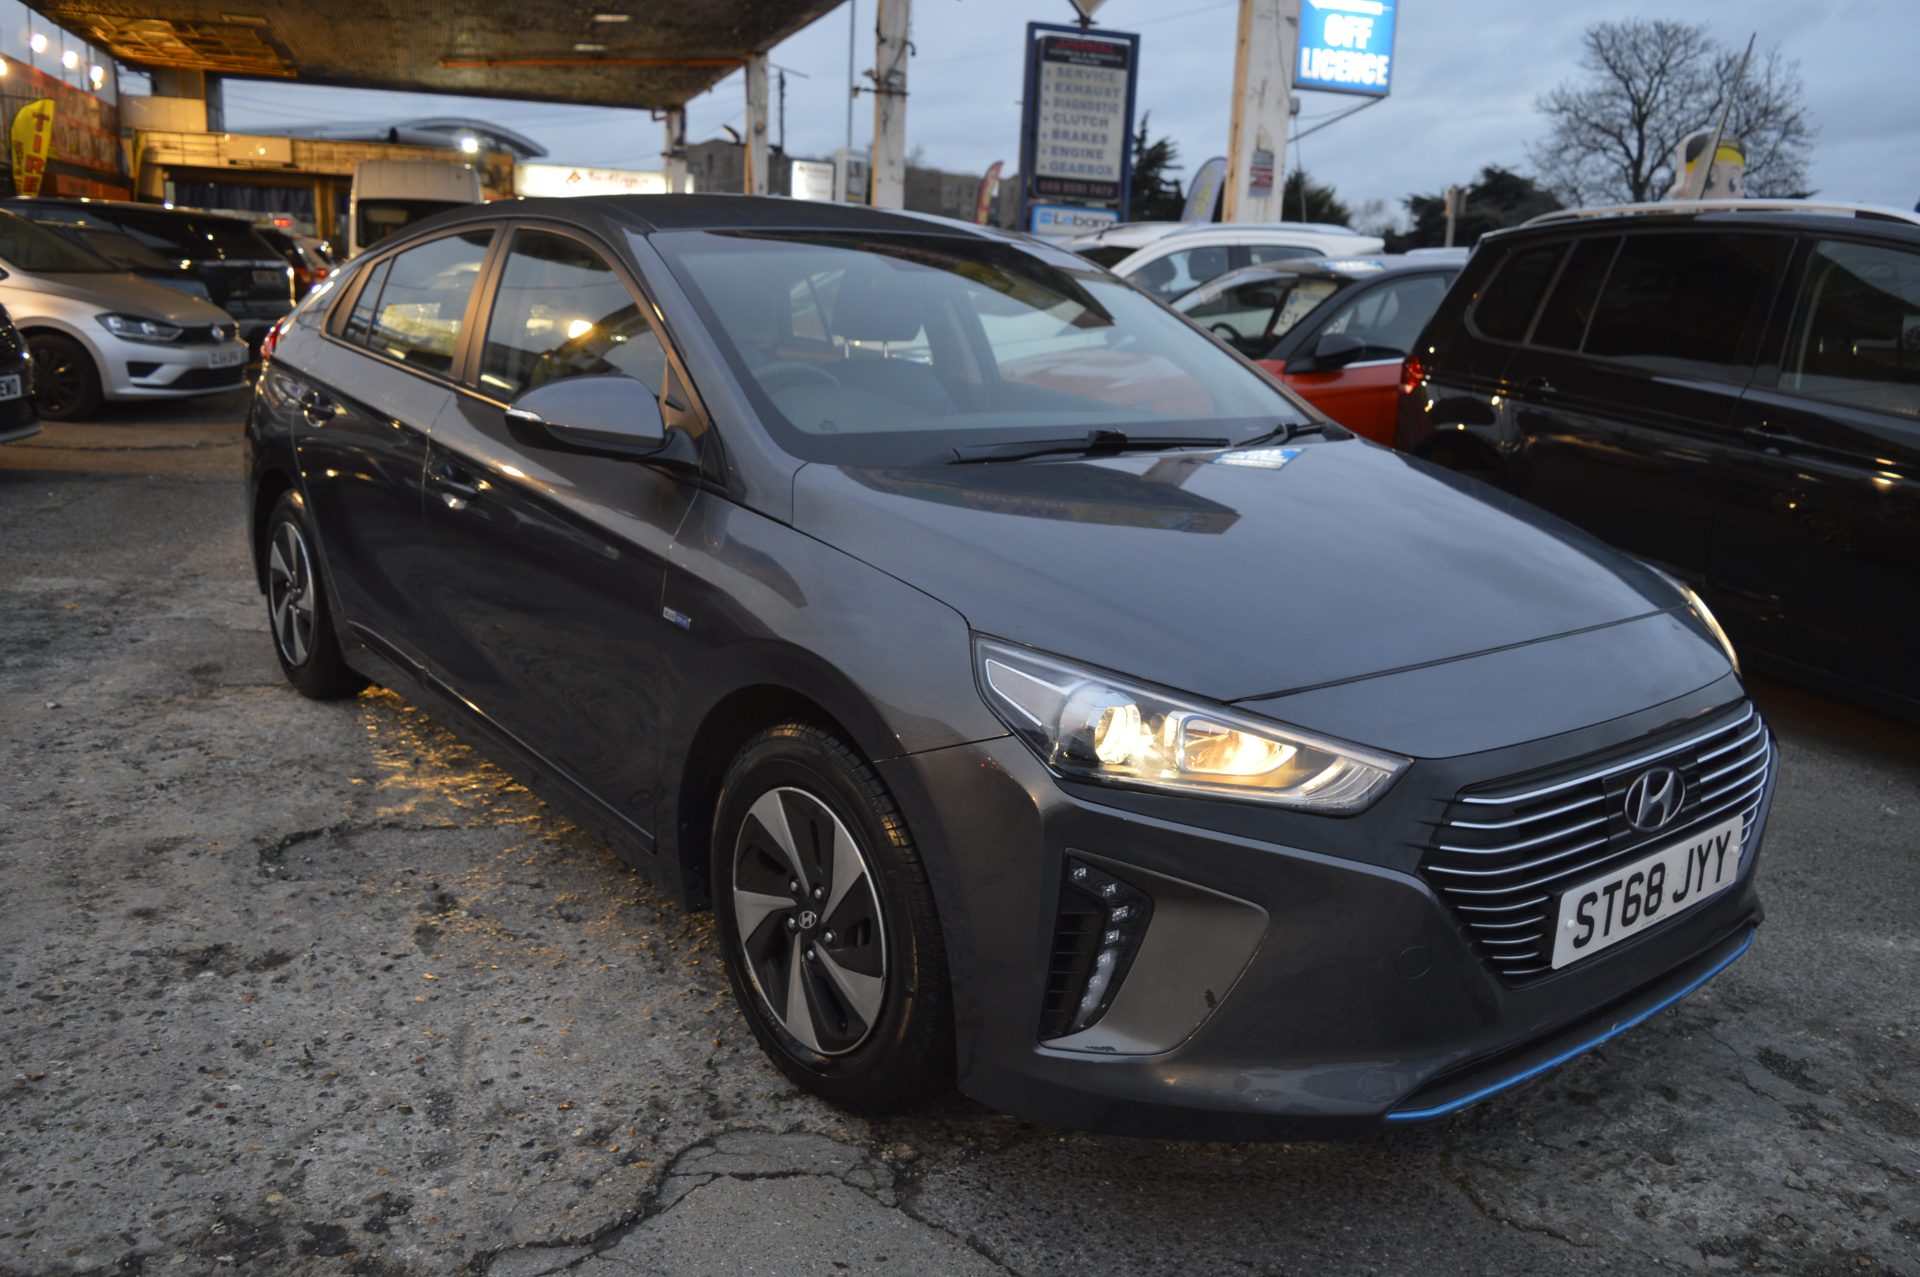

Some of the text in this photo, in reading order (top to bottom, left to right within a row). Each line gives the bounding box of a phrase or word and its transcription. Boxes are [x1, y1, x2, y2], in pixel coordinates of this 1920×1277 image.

[1323, 13, 1374, 49] OFF
[1300, 47, 1389, 85] LICENCE
[1056, 67, 1116, 82] SERVICE
[1055, 83, 1121, 98] EXHAUST
[1053, 98, 1120, 114] DIAGNOSTIC
[1052, 114, 1109, 128] CLUTCH
[1052, 129, 1109, 144] BRAKES
[1051, 146, 1104, 160] ENGINE
[1049, 161, 1114, 176] GEARBOX
[1572, 830, 1732, 949] ST68 JYY
